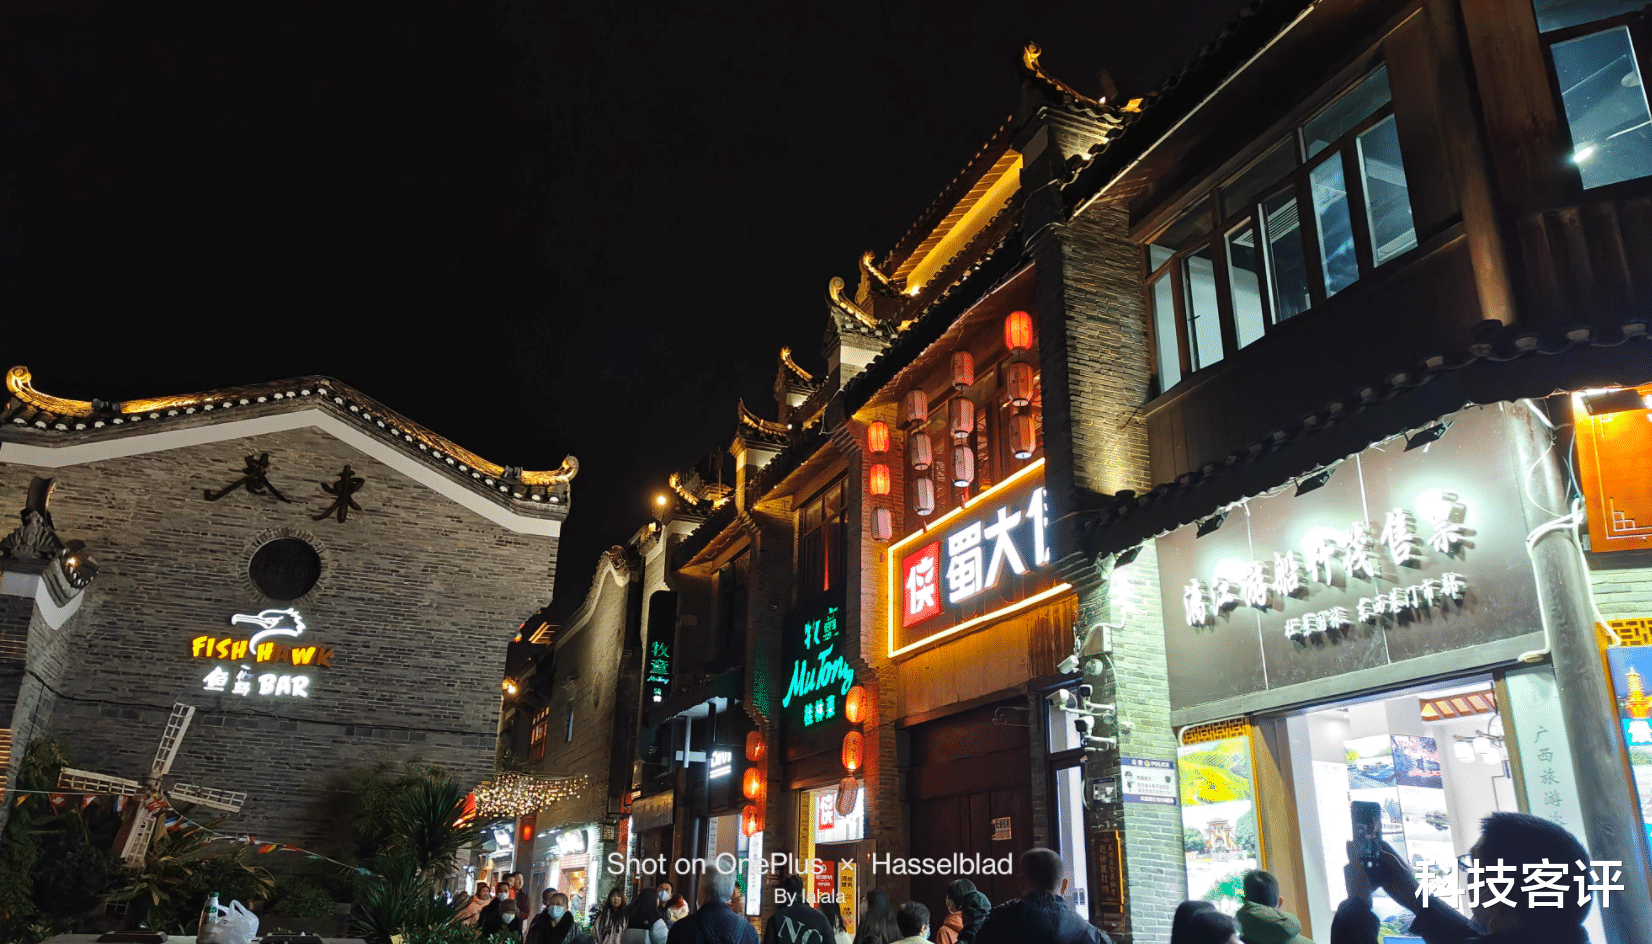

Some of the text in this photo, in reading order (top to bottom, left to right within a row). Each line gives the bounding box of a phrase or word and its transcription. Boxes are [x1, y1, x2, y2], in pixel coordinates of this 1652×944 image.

[192, 635, 334, 668] FISH HAWK
[258, 673, 310, 698] BAR
